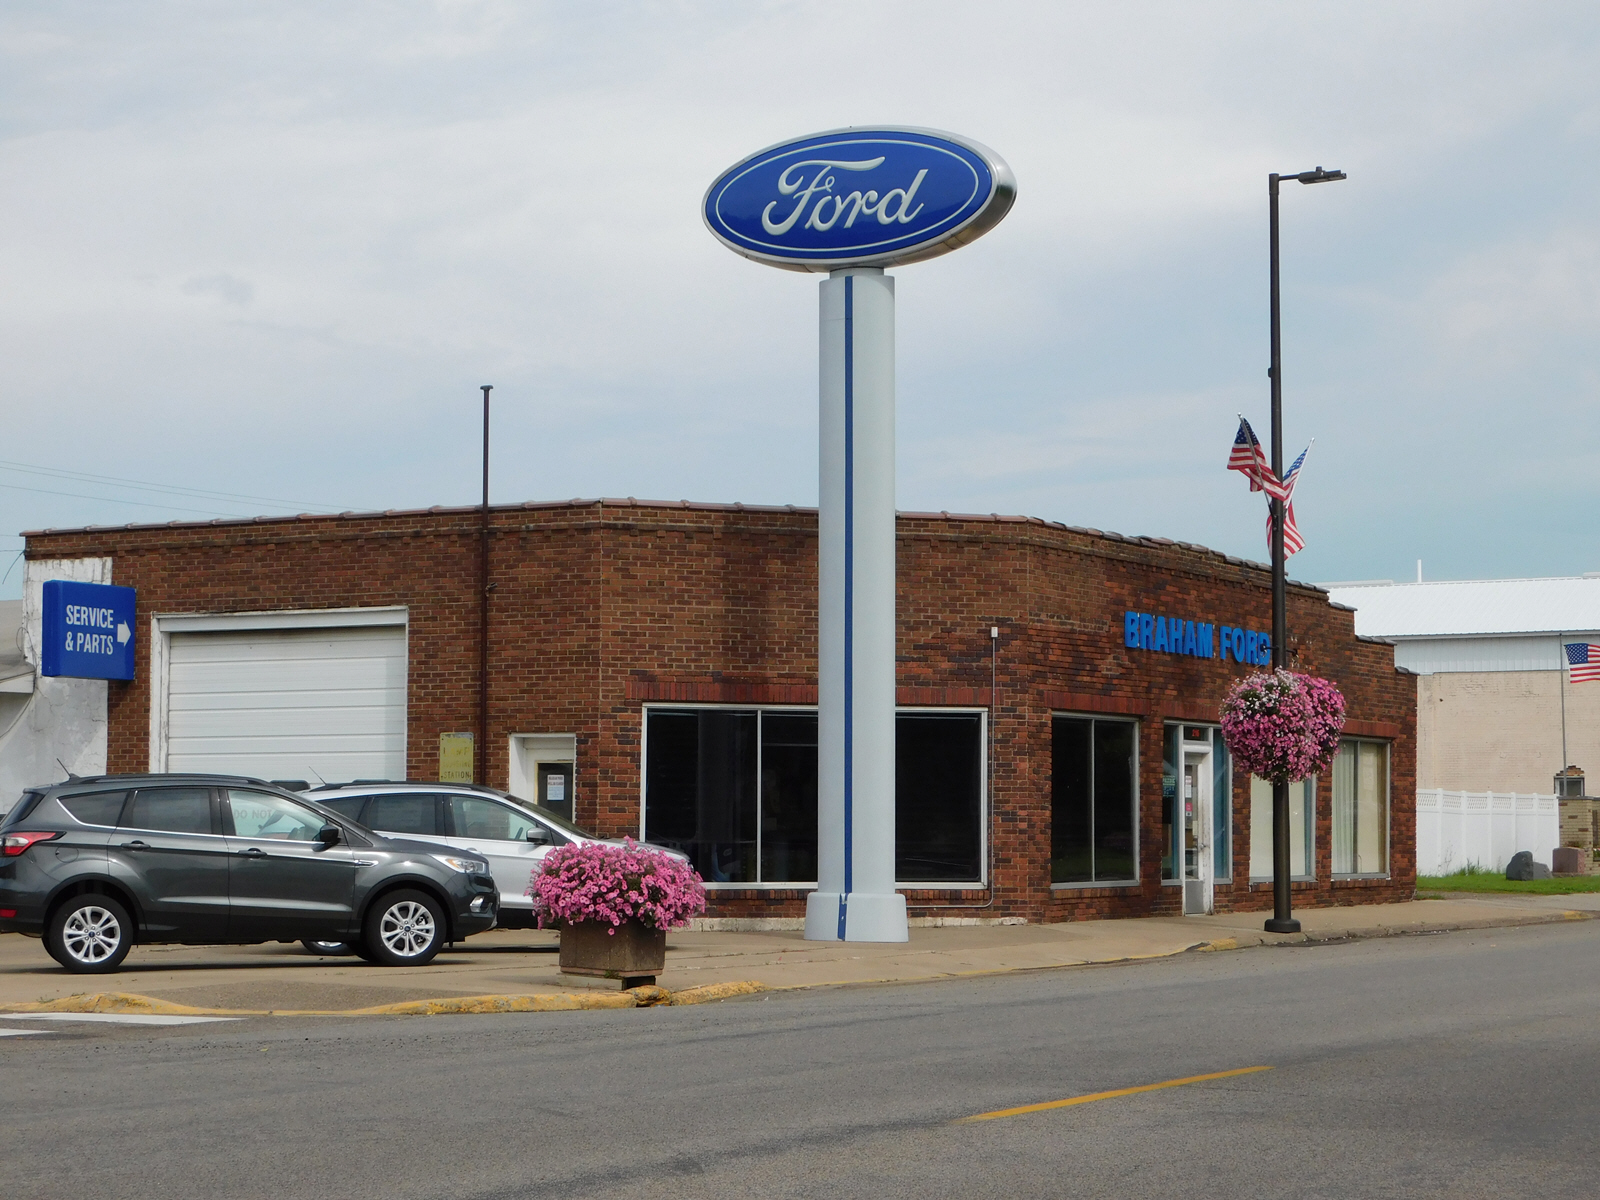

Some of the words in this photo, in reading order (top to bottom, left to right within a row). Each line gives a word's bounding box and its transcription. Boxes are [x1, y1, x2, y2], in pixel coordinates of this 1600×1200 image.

[761, 156, 929, 236] Ford
[65, 604, 114, 629] SERVICE
[65, 631, 73, 652] &
[76, 632, 114, 655] PARTS
[1125, 611, 1214, 658] BRAHAM
[1219, 625, 1271, 666] FORD
